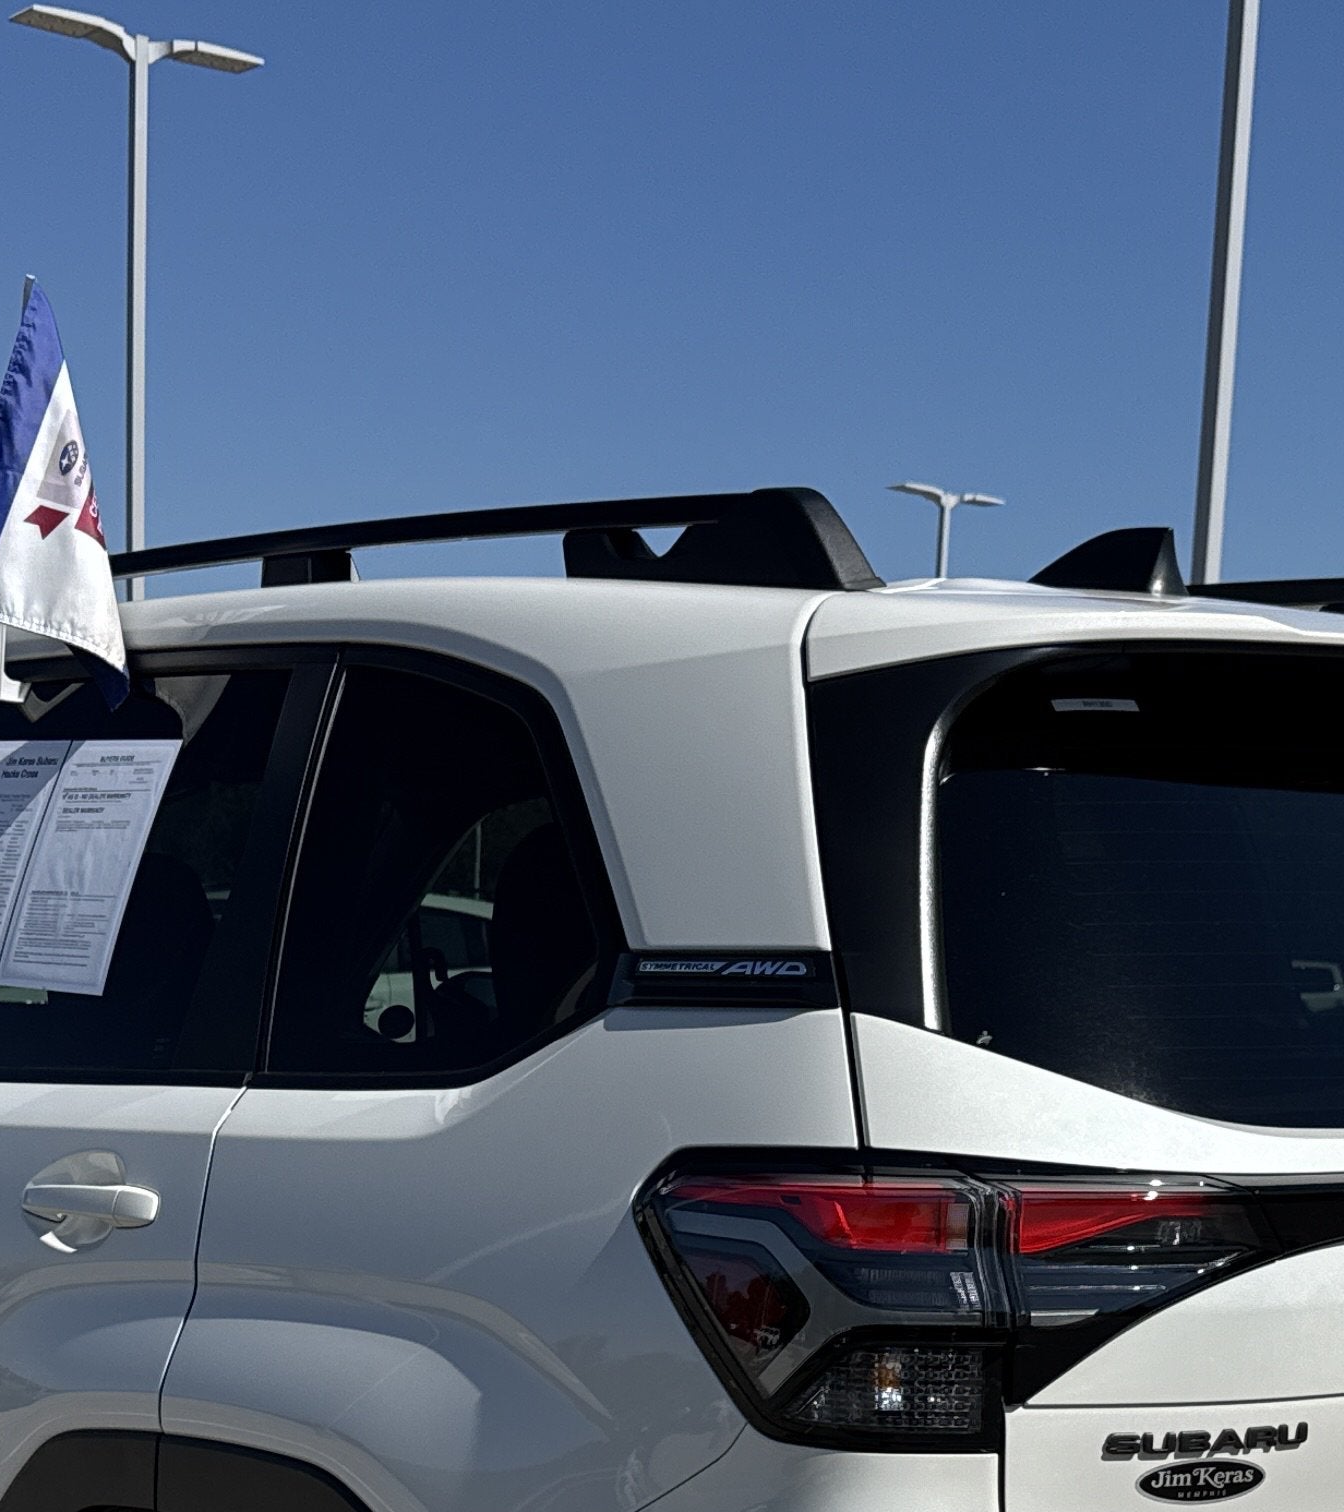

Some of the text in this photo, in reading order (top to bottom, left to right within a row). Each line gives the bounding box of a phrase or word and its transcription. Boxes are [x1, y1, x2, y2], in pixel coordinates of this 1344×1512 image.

[641, 960, 807, 975] SYMMETRICAL AWD
[1102, 1421, 1309, 1456] SUBARU
[1151, 1467, 1254, 1489] Jim Keras
[1177, 1489, 1227, 1498] MEMPHIS
